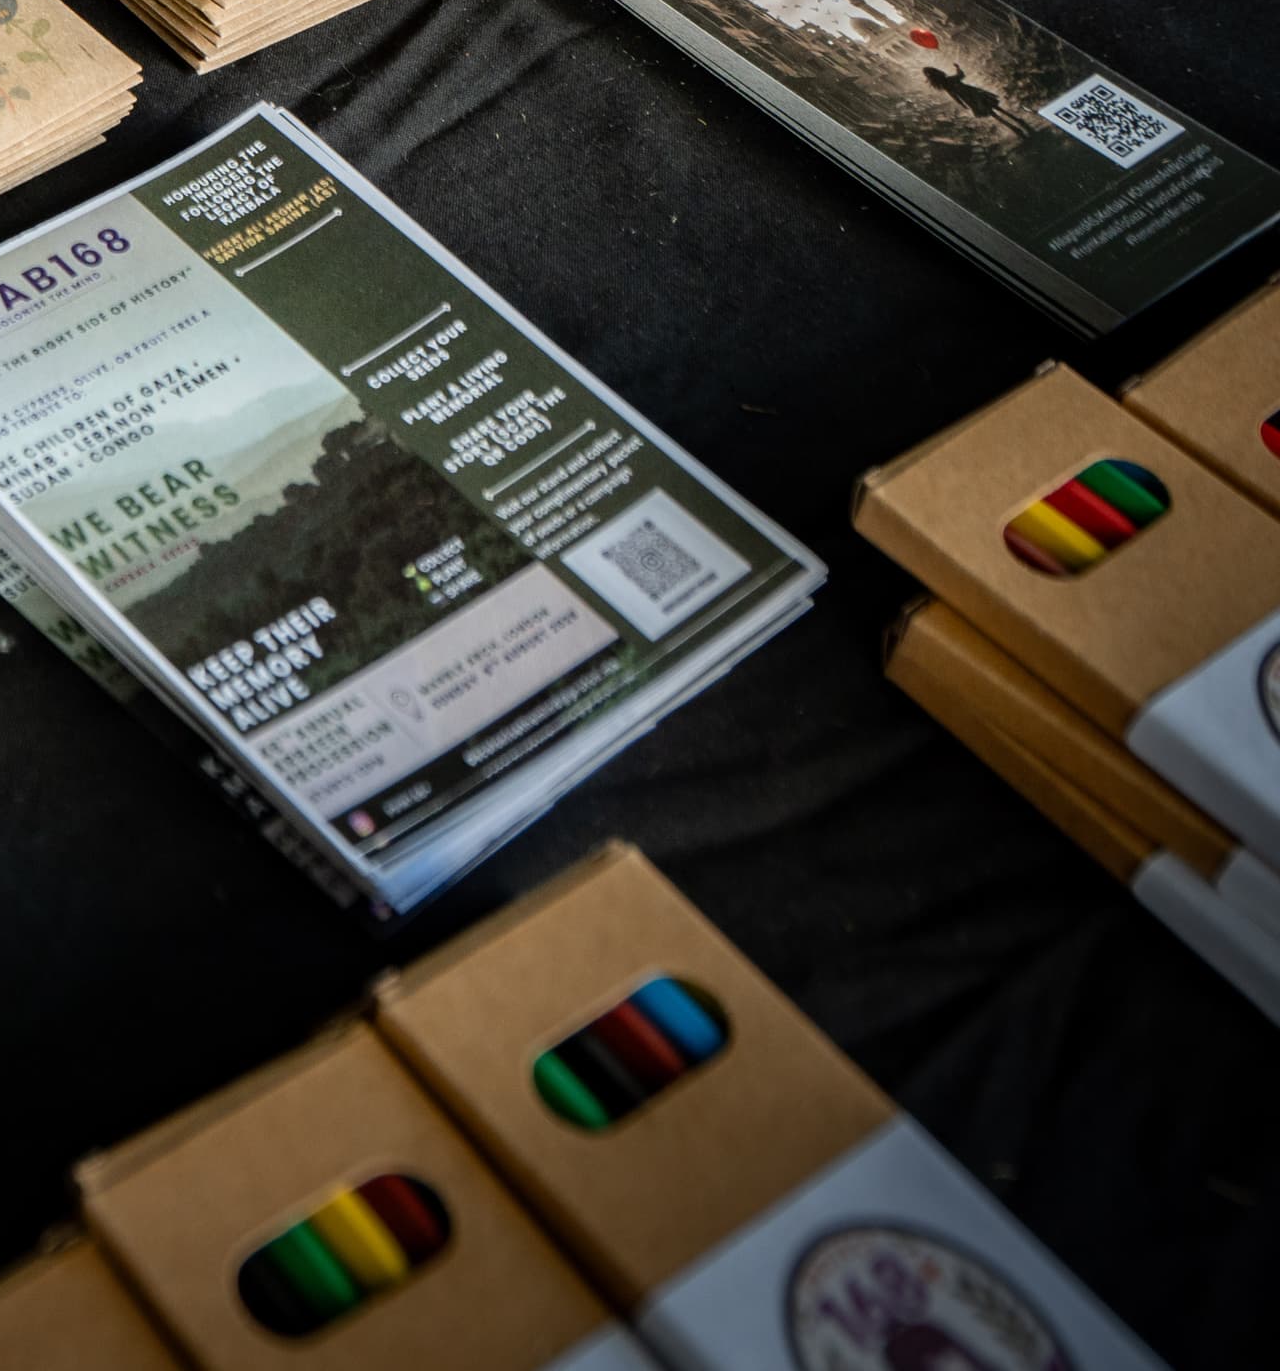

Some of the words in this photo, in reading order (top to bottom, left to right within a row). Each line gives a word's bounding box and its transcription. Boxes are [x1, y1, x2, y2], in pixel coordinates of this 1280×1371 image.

[162, 158, 239, 206] HONOURING
[238, 140, 267, 162] THE
[180, 174, 256, 222] FOLLOWING
[255, 156, 284, 177] THE
[190, 160, 256, 204] INNOCENT
[204, 186, 257, 221] LEGACY
[257, 174, 275, 190] OF
[219, 185, 282, 226] KARBALA
[2, 353, 29, 371] THE
[31, 330, 73, 356] RIGHT
[76, 312, 107, 333] SIDE
[110, 301, 127, 315] OF
[367, 346, 432, 390] COLLECT
[426, 320, 468, 351] YOUR
[406, 348, 450, 382] SEEDS
[22, 408, 110, 458] CHILDREN
[112, 394, 134, 411] OF
[139, 367, 188, 397] GAZA
[73, 403, 155, 452] LEBANON
[170, 362, 229, 397] YEMEN
[401, 391, 448, 425] PLANT
[447, 383, 464, 398] A
[459, 350, 508, 388] LIVING
[429, 372, 504, 424] MEMORIAL
[450, 416, 500, 453] SHARE
[496, 390, 540, 422] YOUR
[9, 466, 72, 505] SUDAN
[89, 424, 154, 462] CONGO
[48, 511, 113, 552] WE
[114, 459, 212, 519] BEAR
[74, 483, 240, 582] WITNESS
[188, 641, 254, 690] KEEP
[254, 597, 336, 652] THEIR
[209, 634, 323, 710] MEMORY
[231, 676, 310, 731] ALIVE
